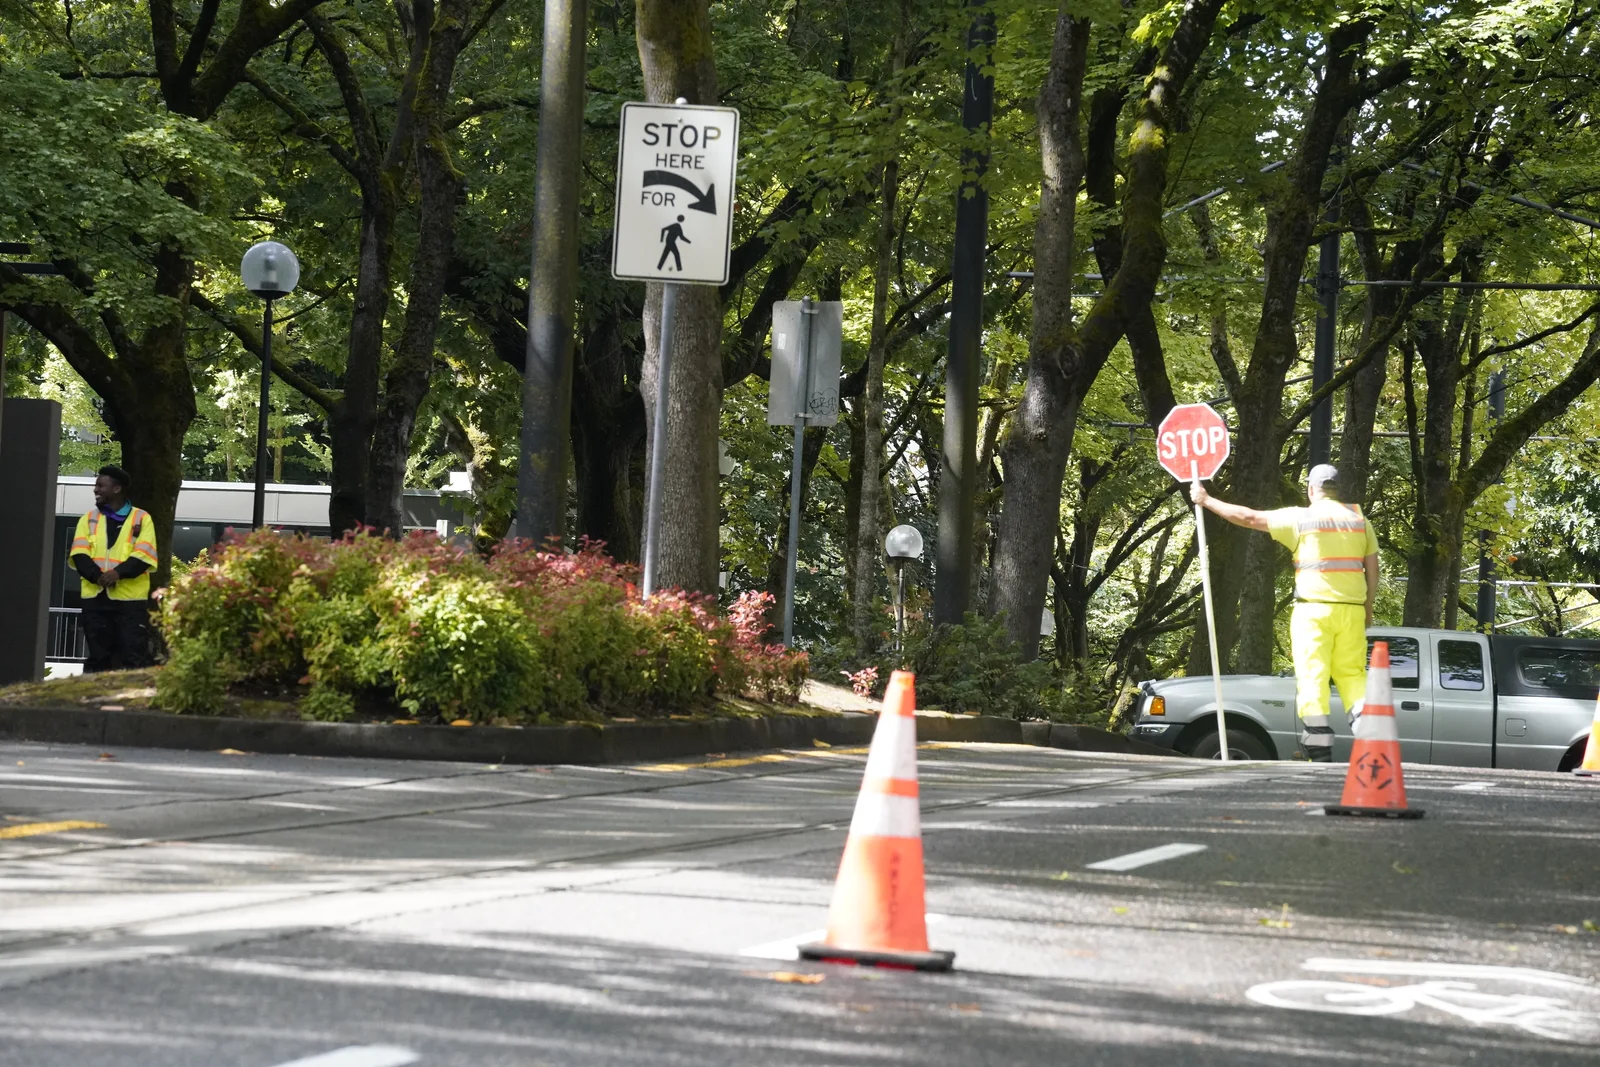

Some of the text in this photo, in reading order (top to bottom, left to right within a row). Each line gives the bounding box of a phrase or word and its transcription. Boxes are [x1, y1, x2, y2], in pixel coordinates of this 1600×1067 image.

[642, 122, 721, 149] STOP
[655, 153, 705, 170] HERE
[641, 191, 676, 207] FOR
[1161, 426, 1224, 459] STOP
